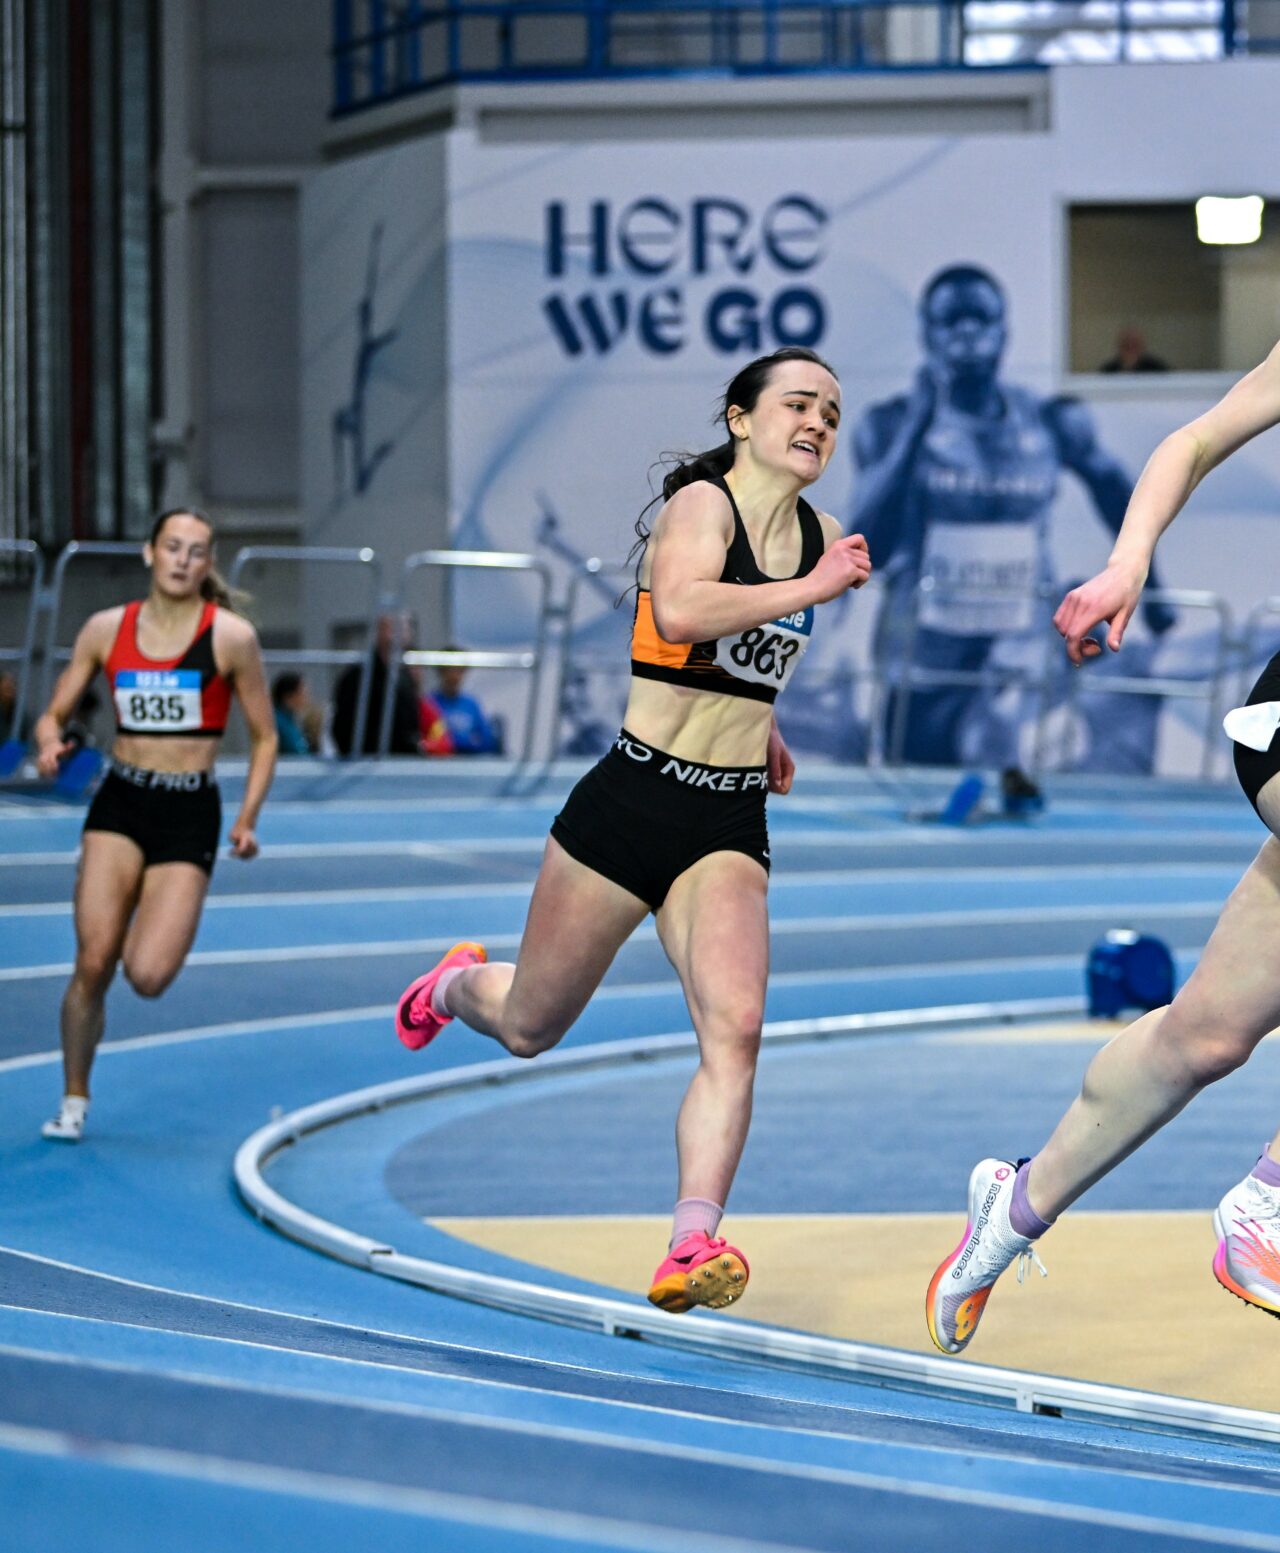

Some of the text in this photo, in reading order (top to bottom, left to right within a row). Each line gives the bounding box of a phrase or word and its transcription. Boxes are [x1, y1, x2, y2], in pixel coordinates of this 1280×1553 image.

[546, 196, 827, 276] HERE
[545, 286, 826, 354] WE GO
[730, 627, 799, 680] 863
[131, 694, 184, 721] 835
[660, 759, 741, 791] NIKE
[952, 1183, 1001, 1280] new balance
